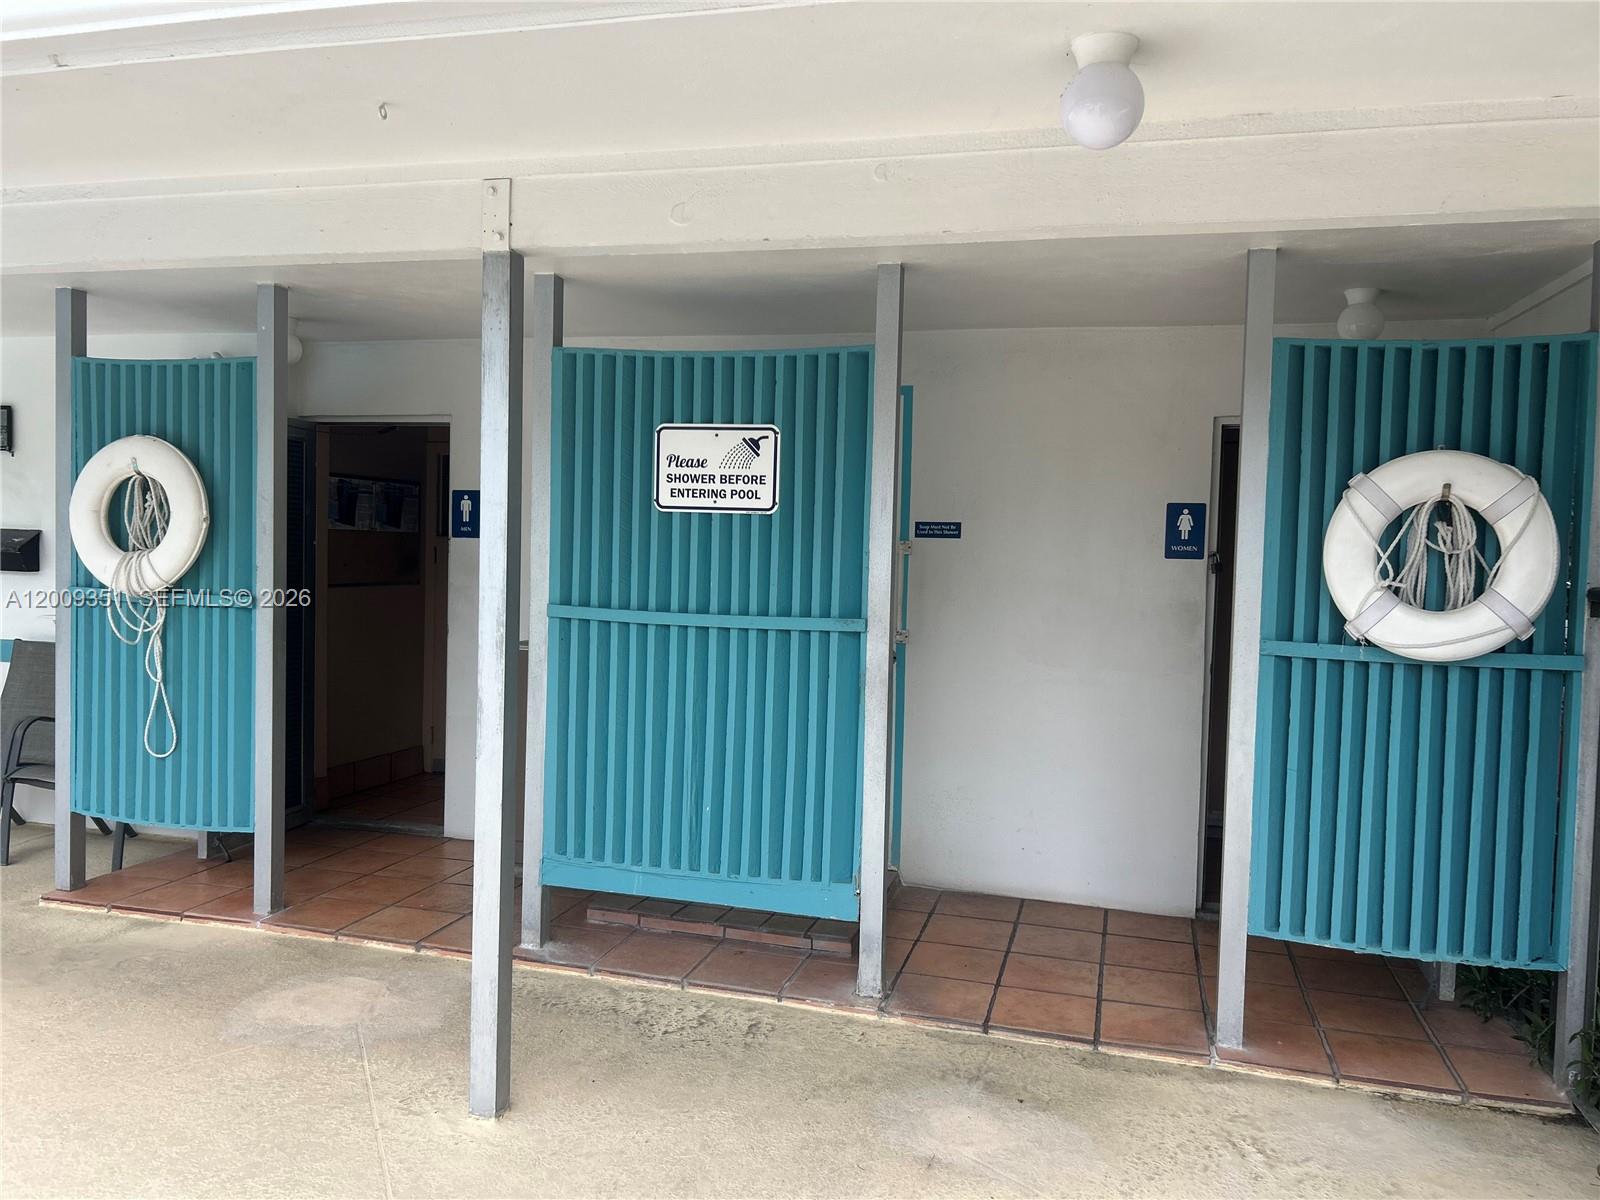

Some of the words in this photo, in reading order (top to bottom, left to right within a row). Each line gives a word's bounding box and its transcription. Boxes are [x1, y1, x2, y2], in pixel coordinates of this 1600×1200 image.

[666, 454, 708, 468] Please
[666, 473, 716, 484] SHOWER
[720, 474, 767, 485] BEFORE
[670, 488, 727, 499] ENTERING
[730, 489, 761, 500] POOL
